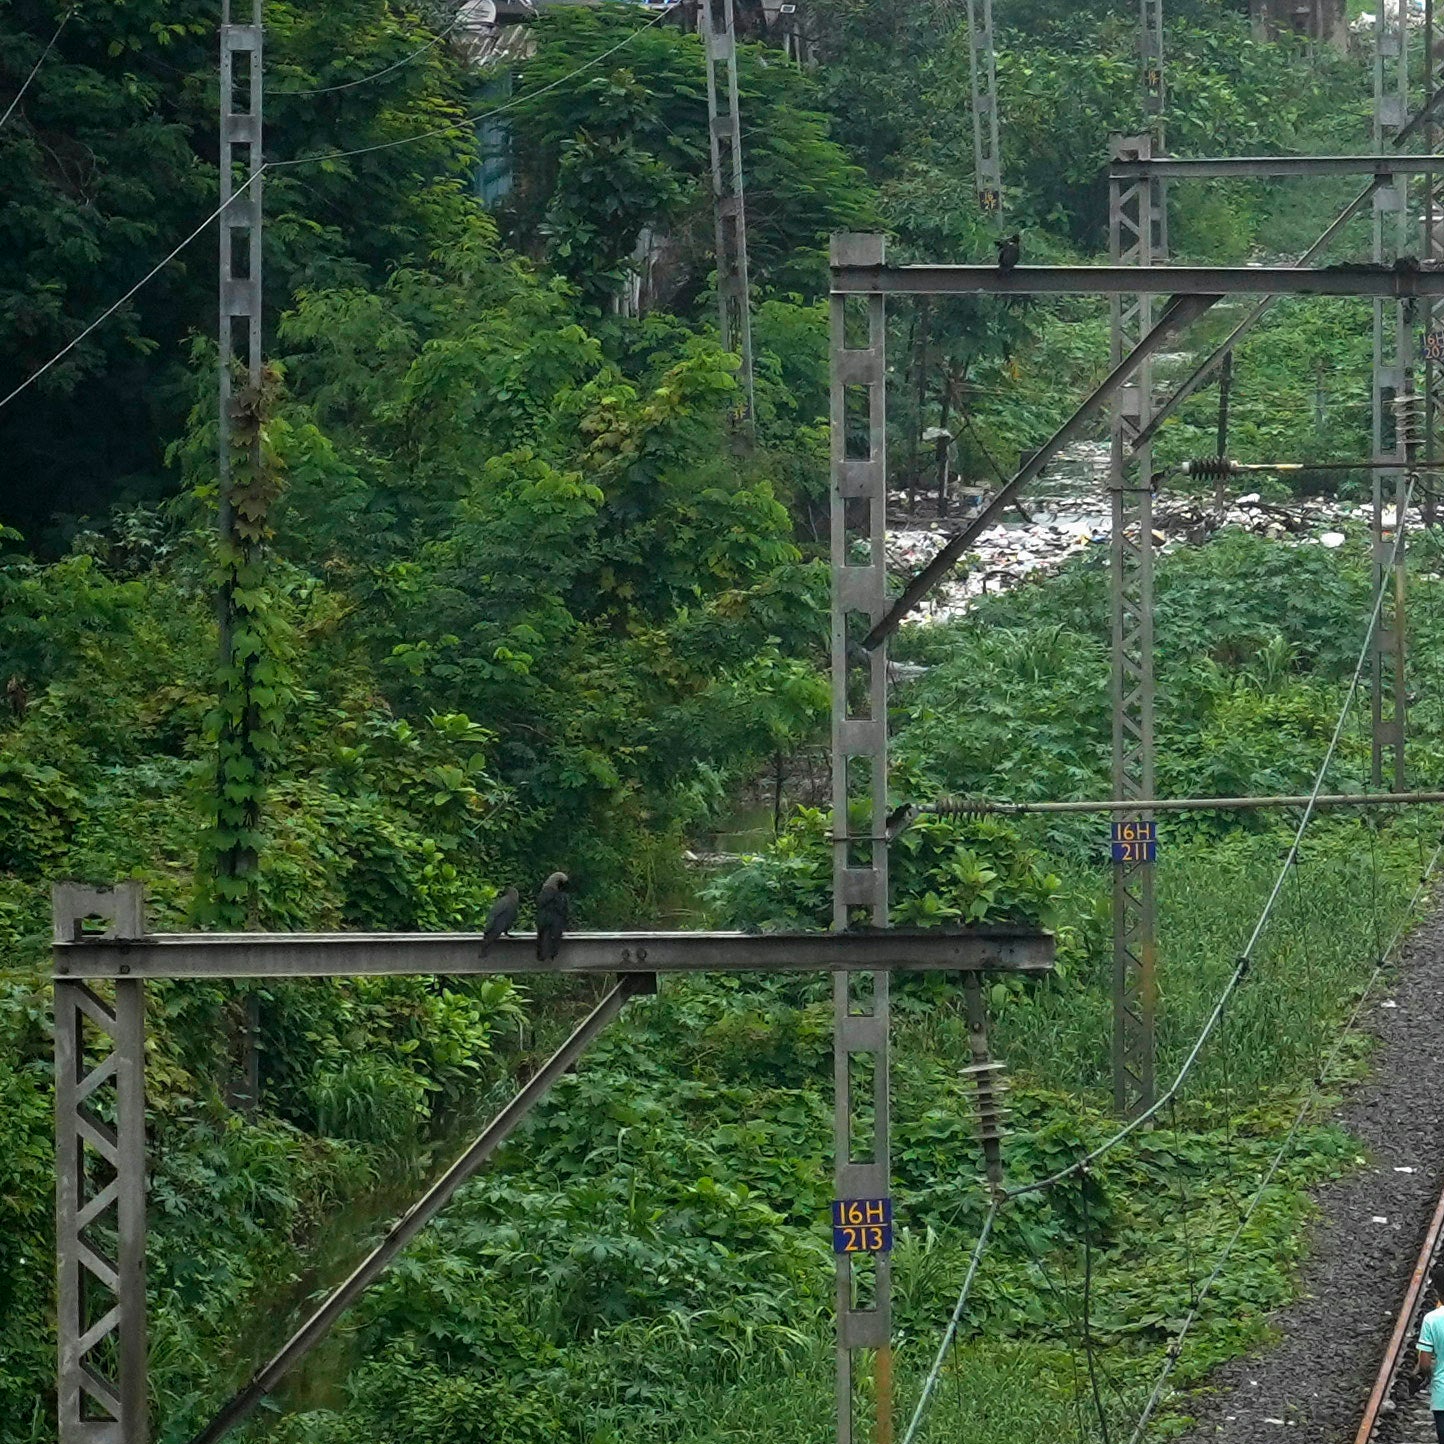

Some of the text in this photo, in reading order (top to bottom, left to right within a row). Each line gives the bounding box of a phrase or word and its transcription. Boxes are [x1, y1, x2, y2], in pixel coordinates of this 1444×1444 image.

[1423, 330, 1444, 346] 16H
[1117, 823, 1150, 840] 16H
[1121, 843, 1147, 860] 211
[840, 1200, 883, 1225] 16H
[843, 1227, 883, 1251] 213
